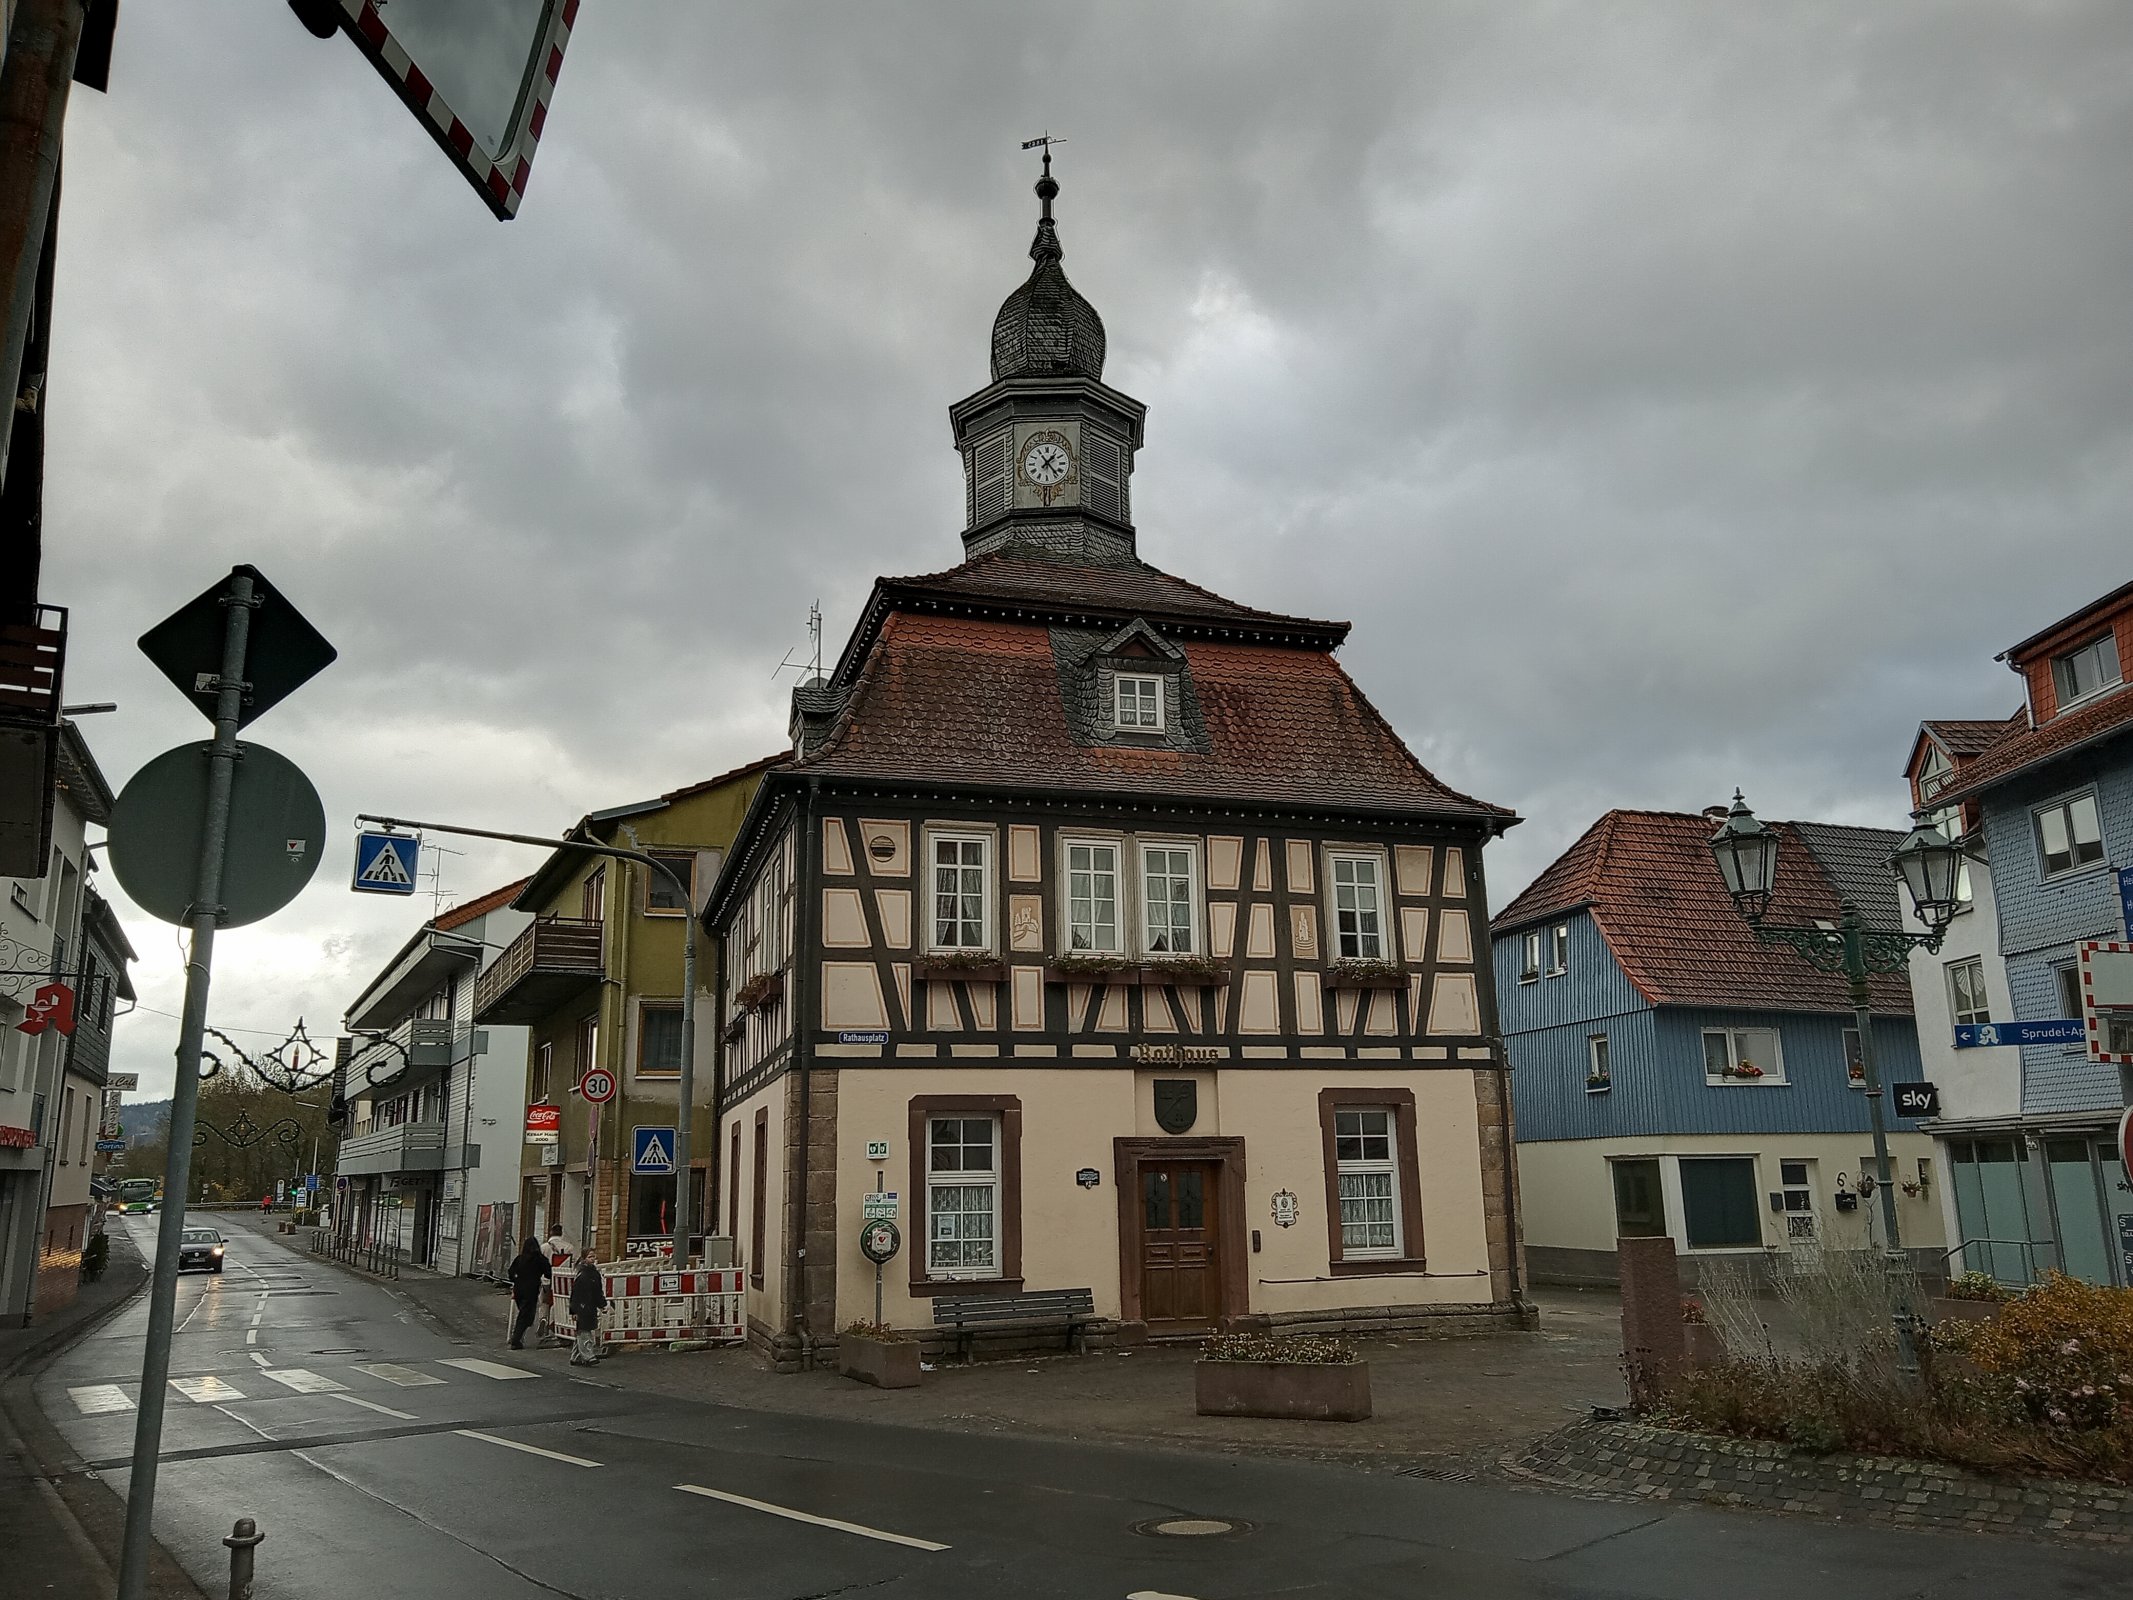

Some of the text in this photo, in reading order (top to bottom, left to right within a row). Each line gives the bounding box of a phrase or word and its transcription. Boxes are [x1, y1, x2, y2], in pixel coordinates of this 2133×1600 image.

[843, 1033, 885, 1044] Rathausplatz
[1137, 1043, 1219, 1068] Rathaus
[587, 1078, 609, 1094] 30
[1902, 1090, 1931, 1109] sky
[1836, 1172, 1848, 1187] 6
